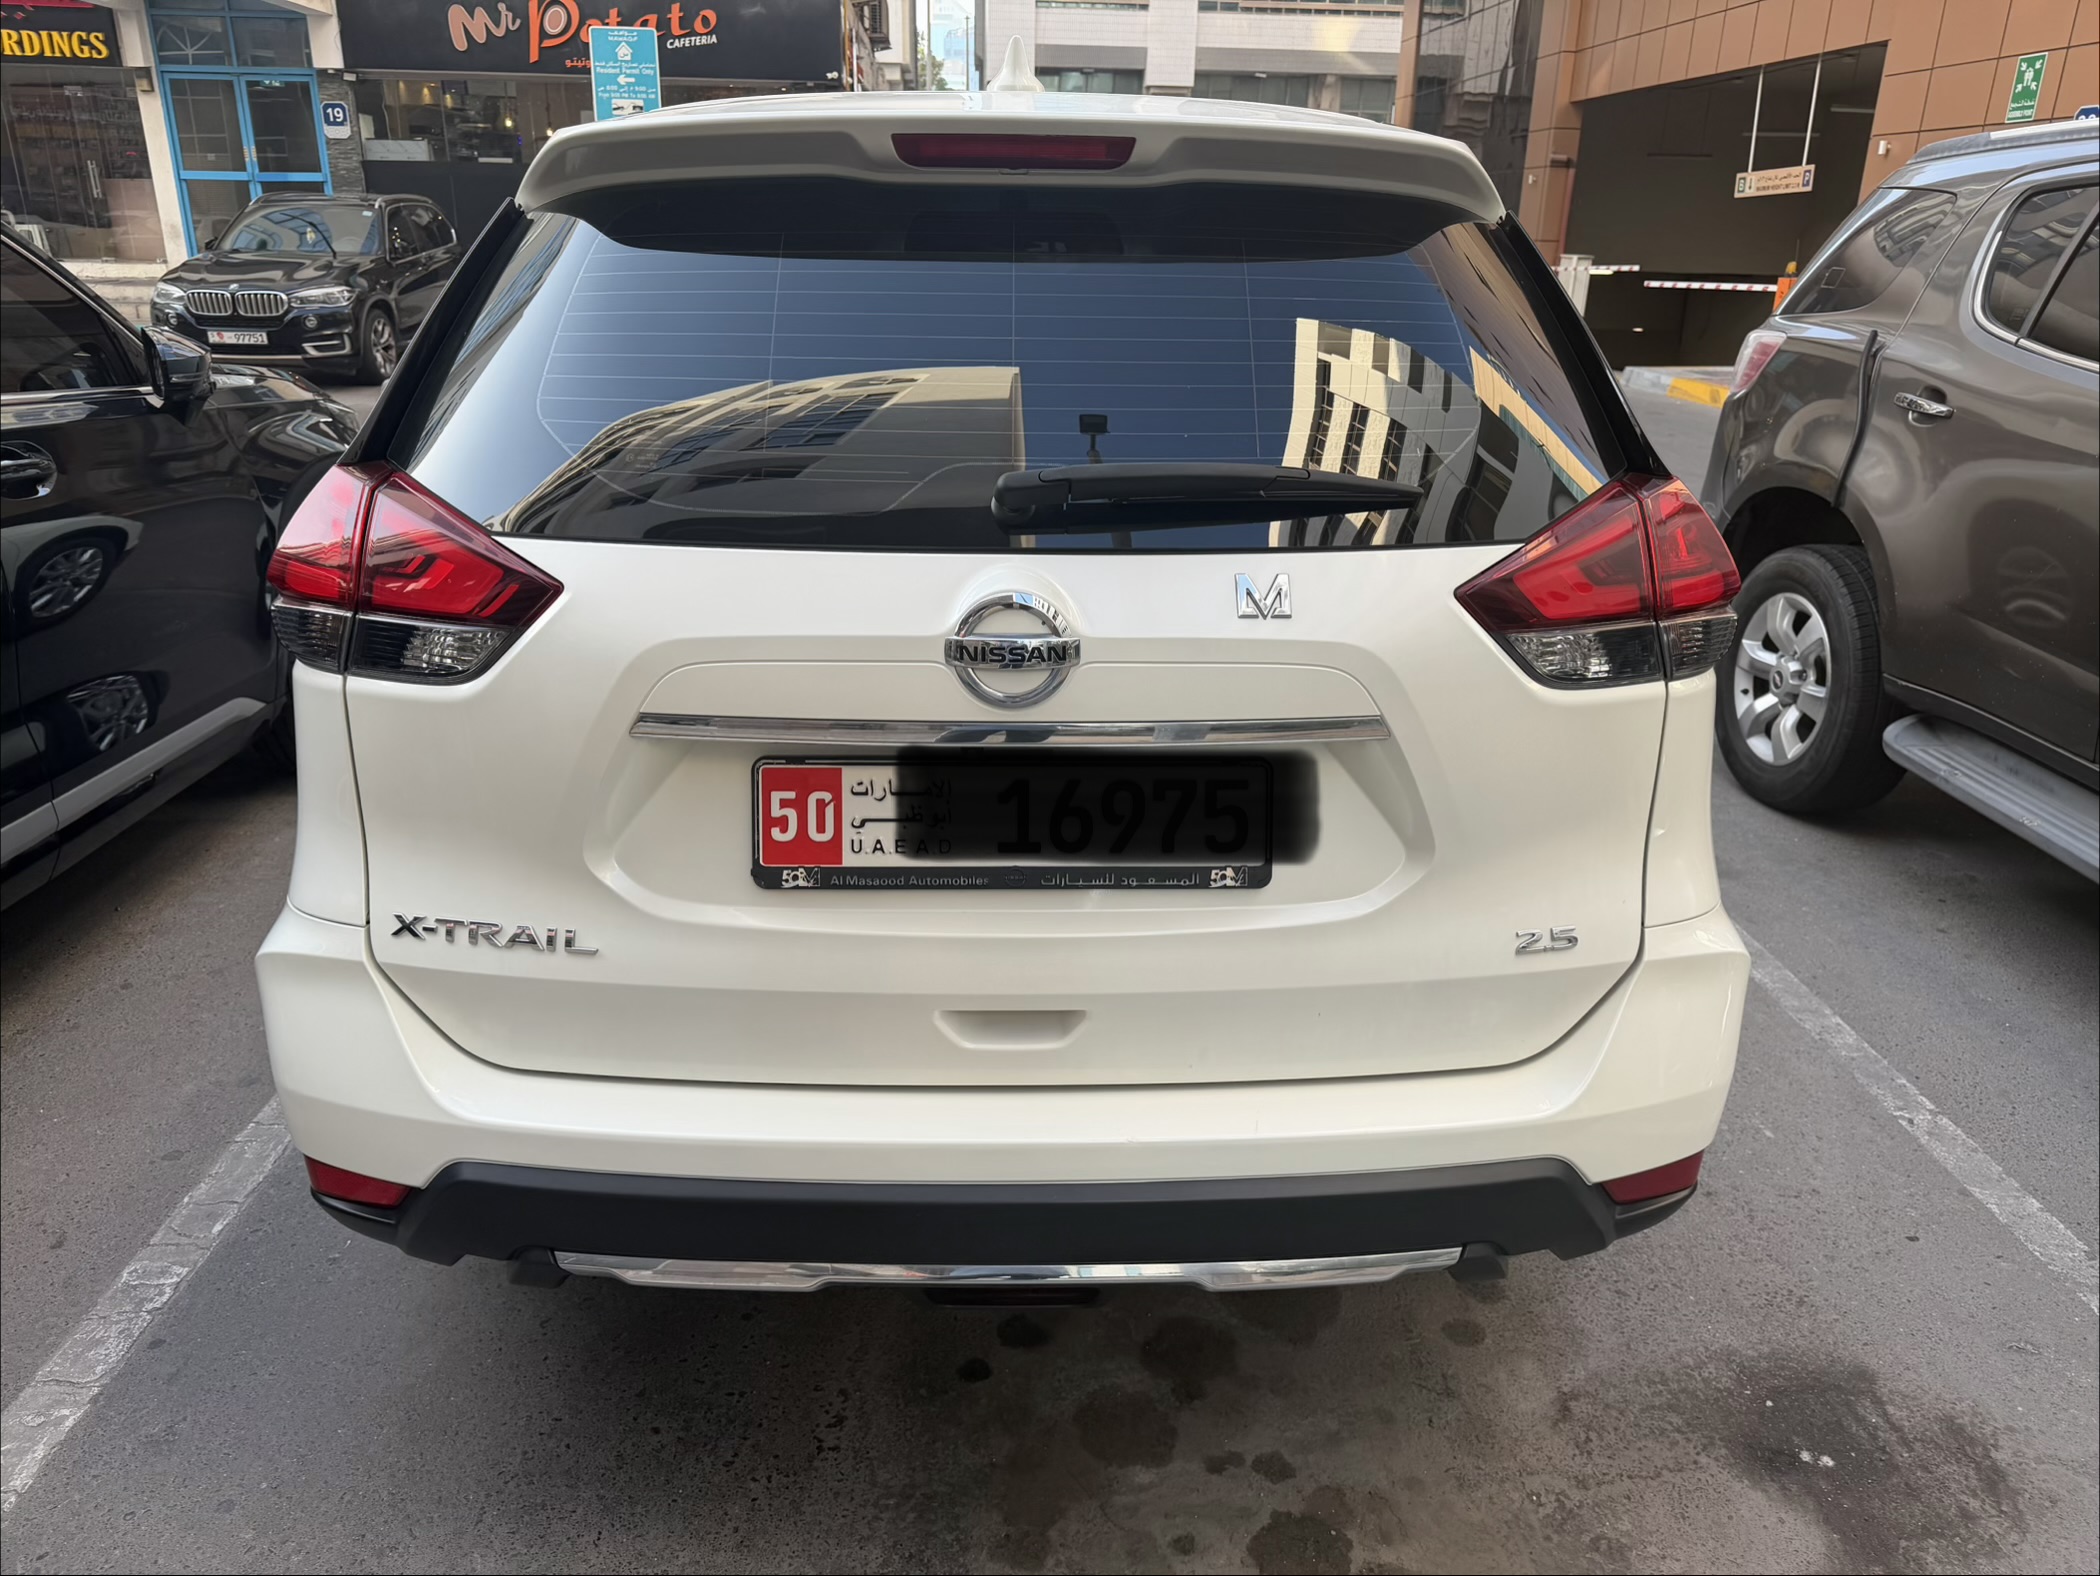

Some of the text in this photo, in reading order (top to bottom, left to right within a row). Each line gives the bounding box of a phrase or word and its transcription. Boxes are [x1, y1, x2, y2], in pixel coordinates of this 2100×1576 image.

[447, 3, 521, 52] Mr
[666, 34, 718, 49] CAFETERIA
[622, 67, 640, 75] Permit
[641, 68, 654, 76] Only
[326, 107, 344, 122] 19
[234, 333, 266, 343] 97751
[1234, 573, 1292, 619] M
[958, 645, 1068, 664] NISSAN
[770, 790, 836, 843] 50
[830, 874, 990, 886] Al Masaood Automobiles
[1041, 873, 1199, 887] المسعود للسيارات
[391, 912, 599, 956] X-TRAIL
